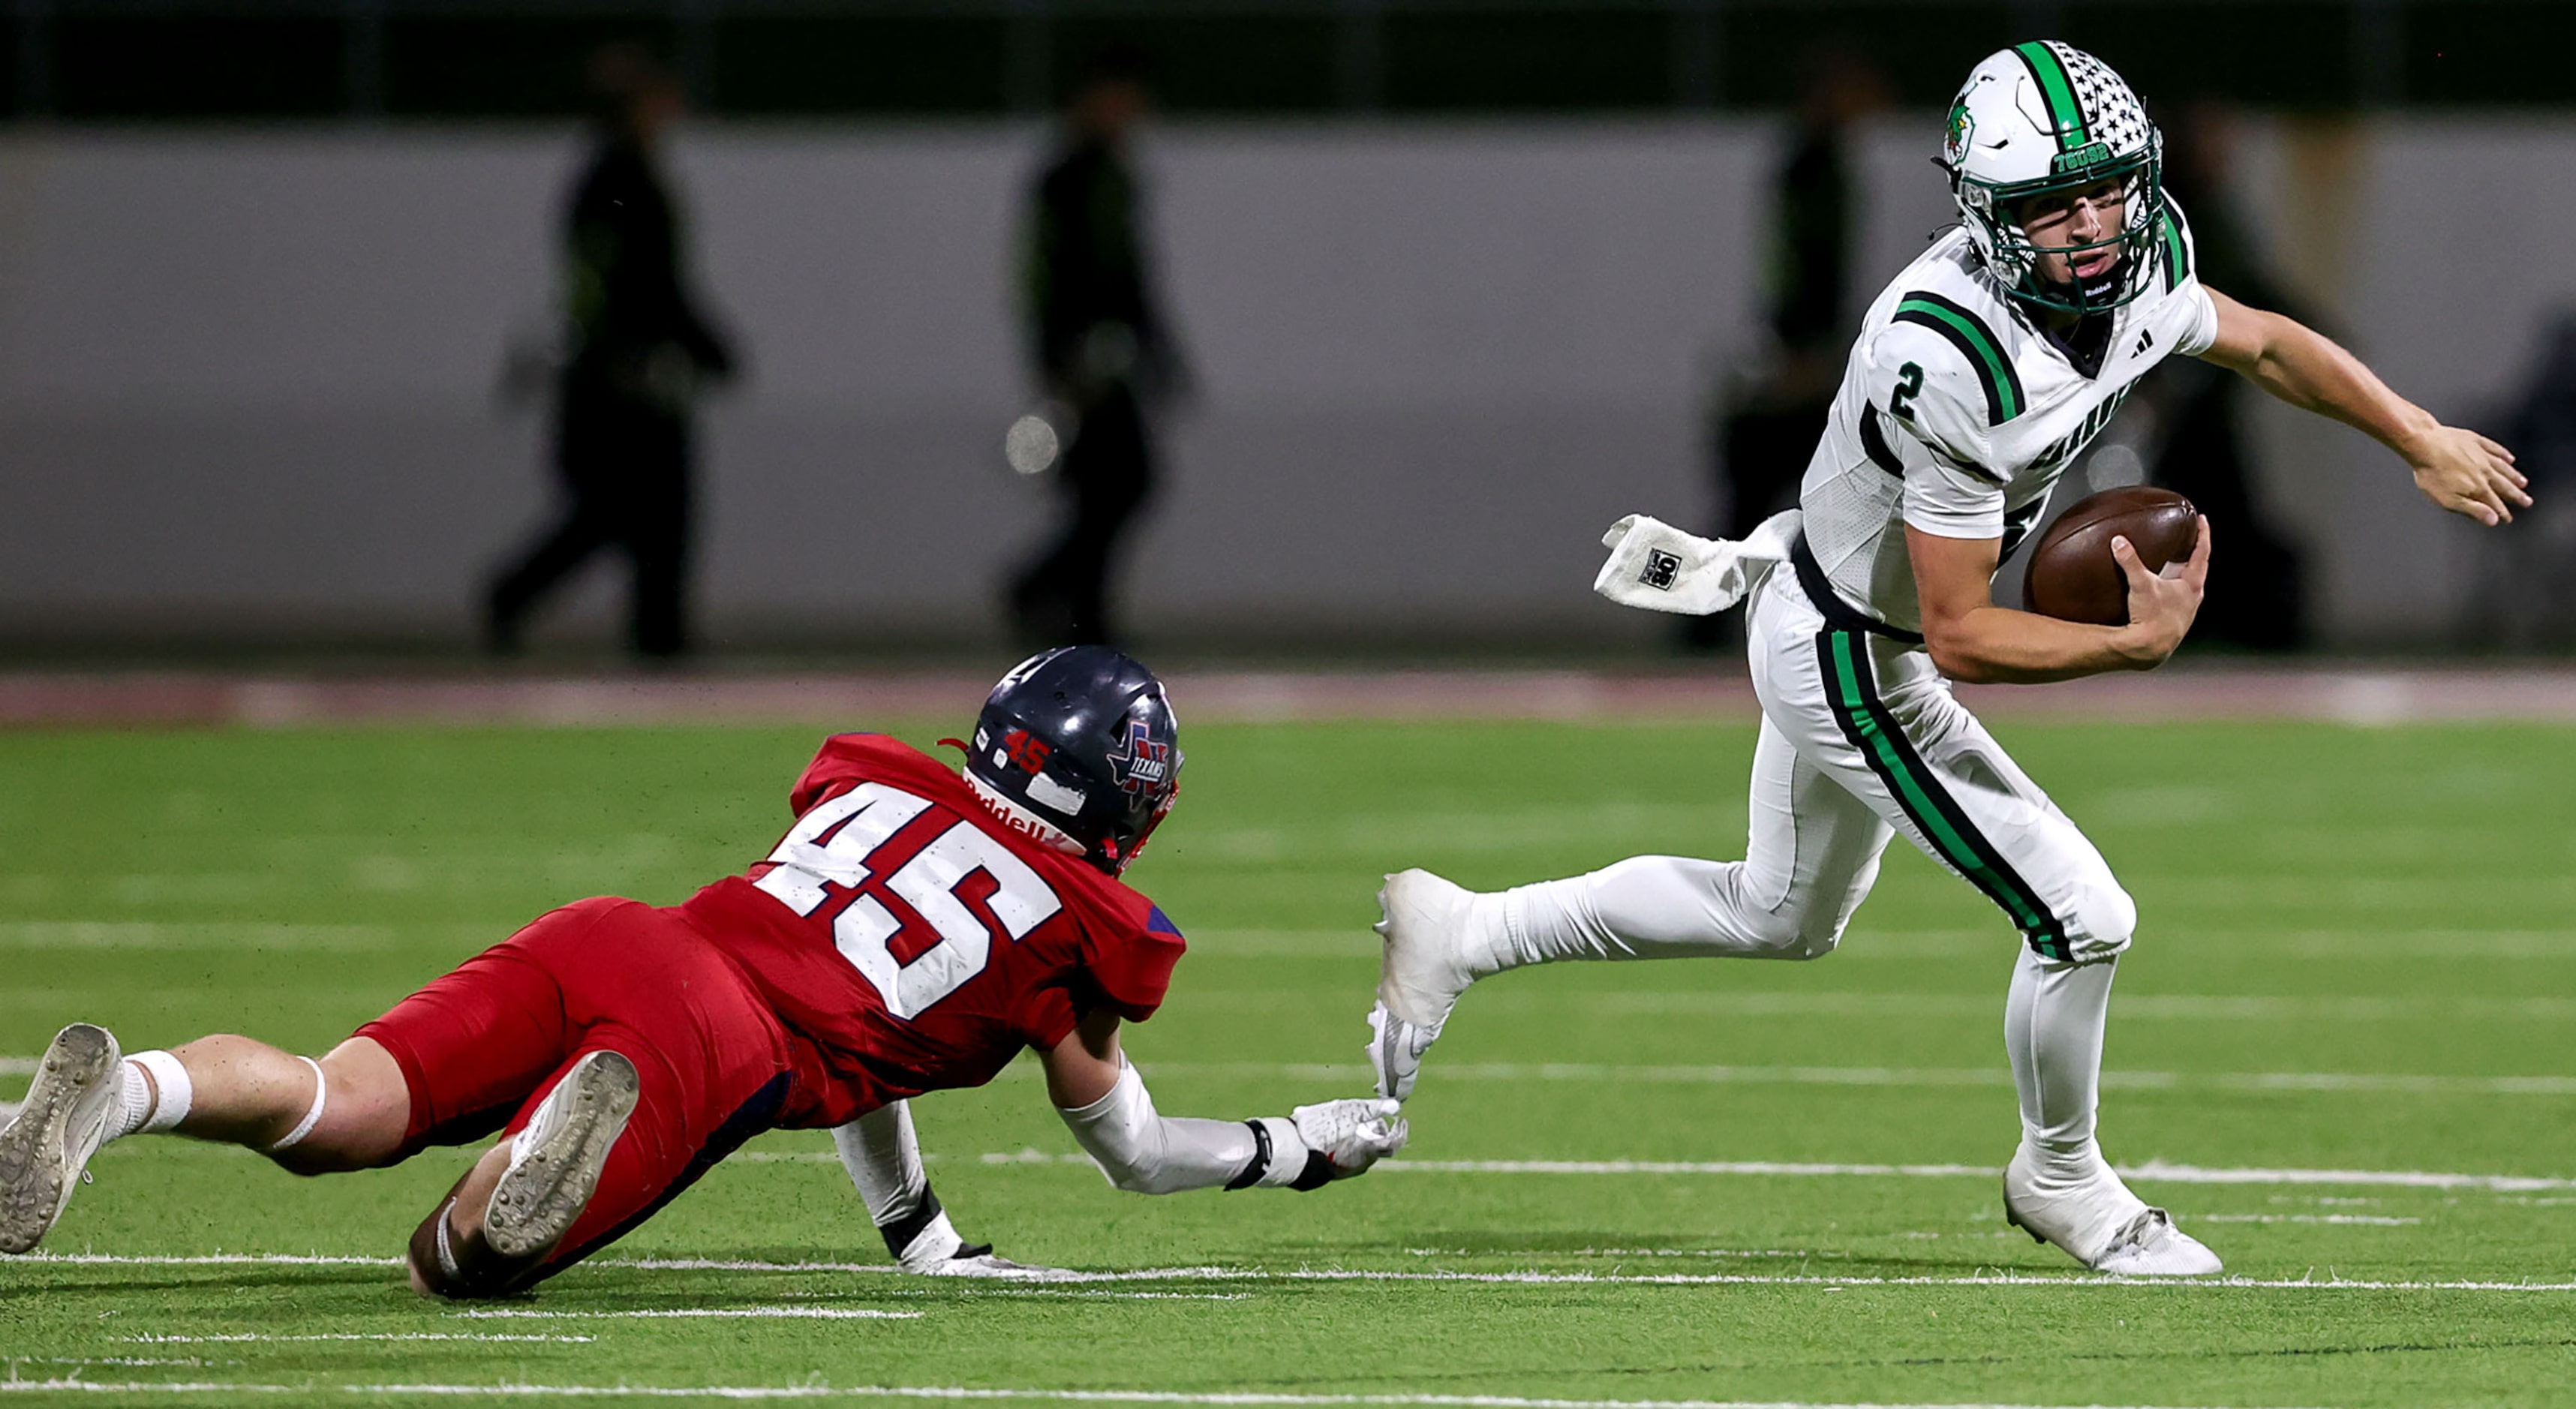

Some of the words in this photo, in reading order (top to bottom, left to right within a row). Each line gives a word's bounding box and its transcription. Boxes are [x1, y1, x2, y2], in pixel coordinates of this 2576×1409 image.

[2054, 143, 2109, 173] 76092
[1889, 360, 1925, 422] 2
[1004, 729, 1051, 776] 45
[1130, 756, 1165, 778] TEXANS
[752, 781, 1063, 1021] 45
